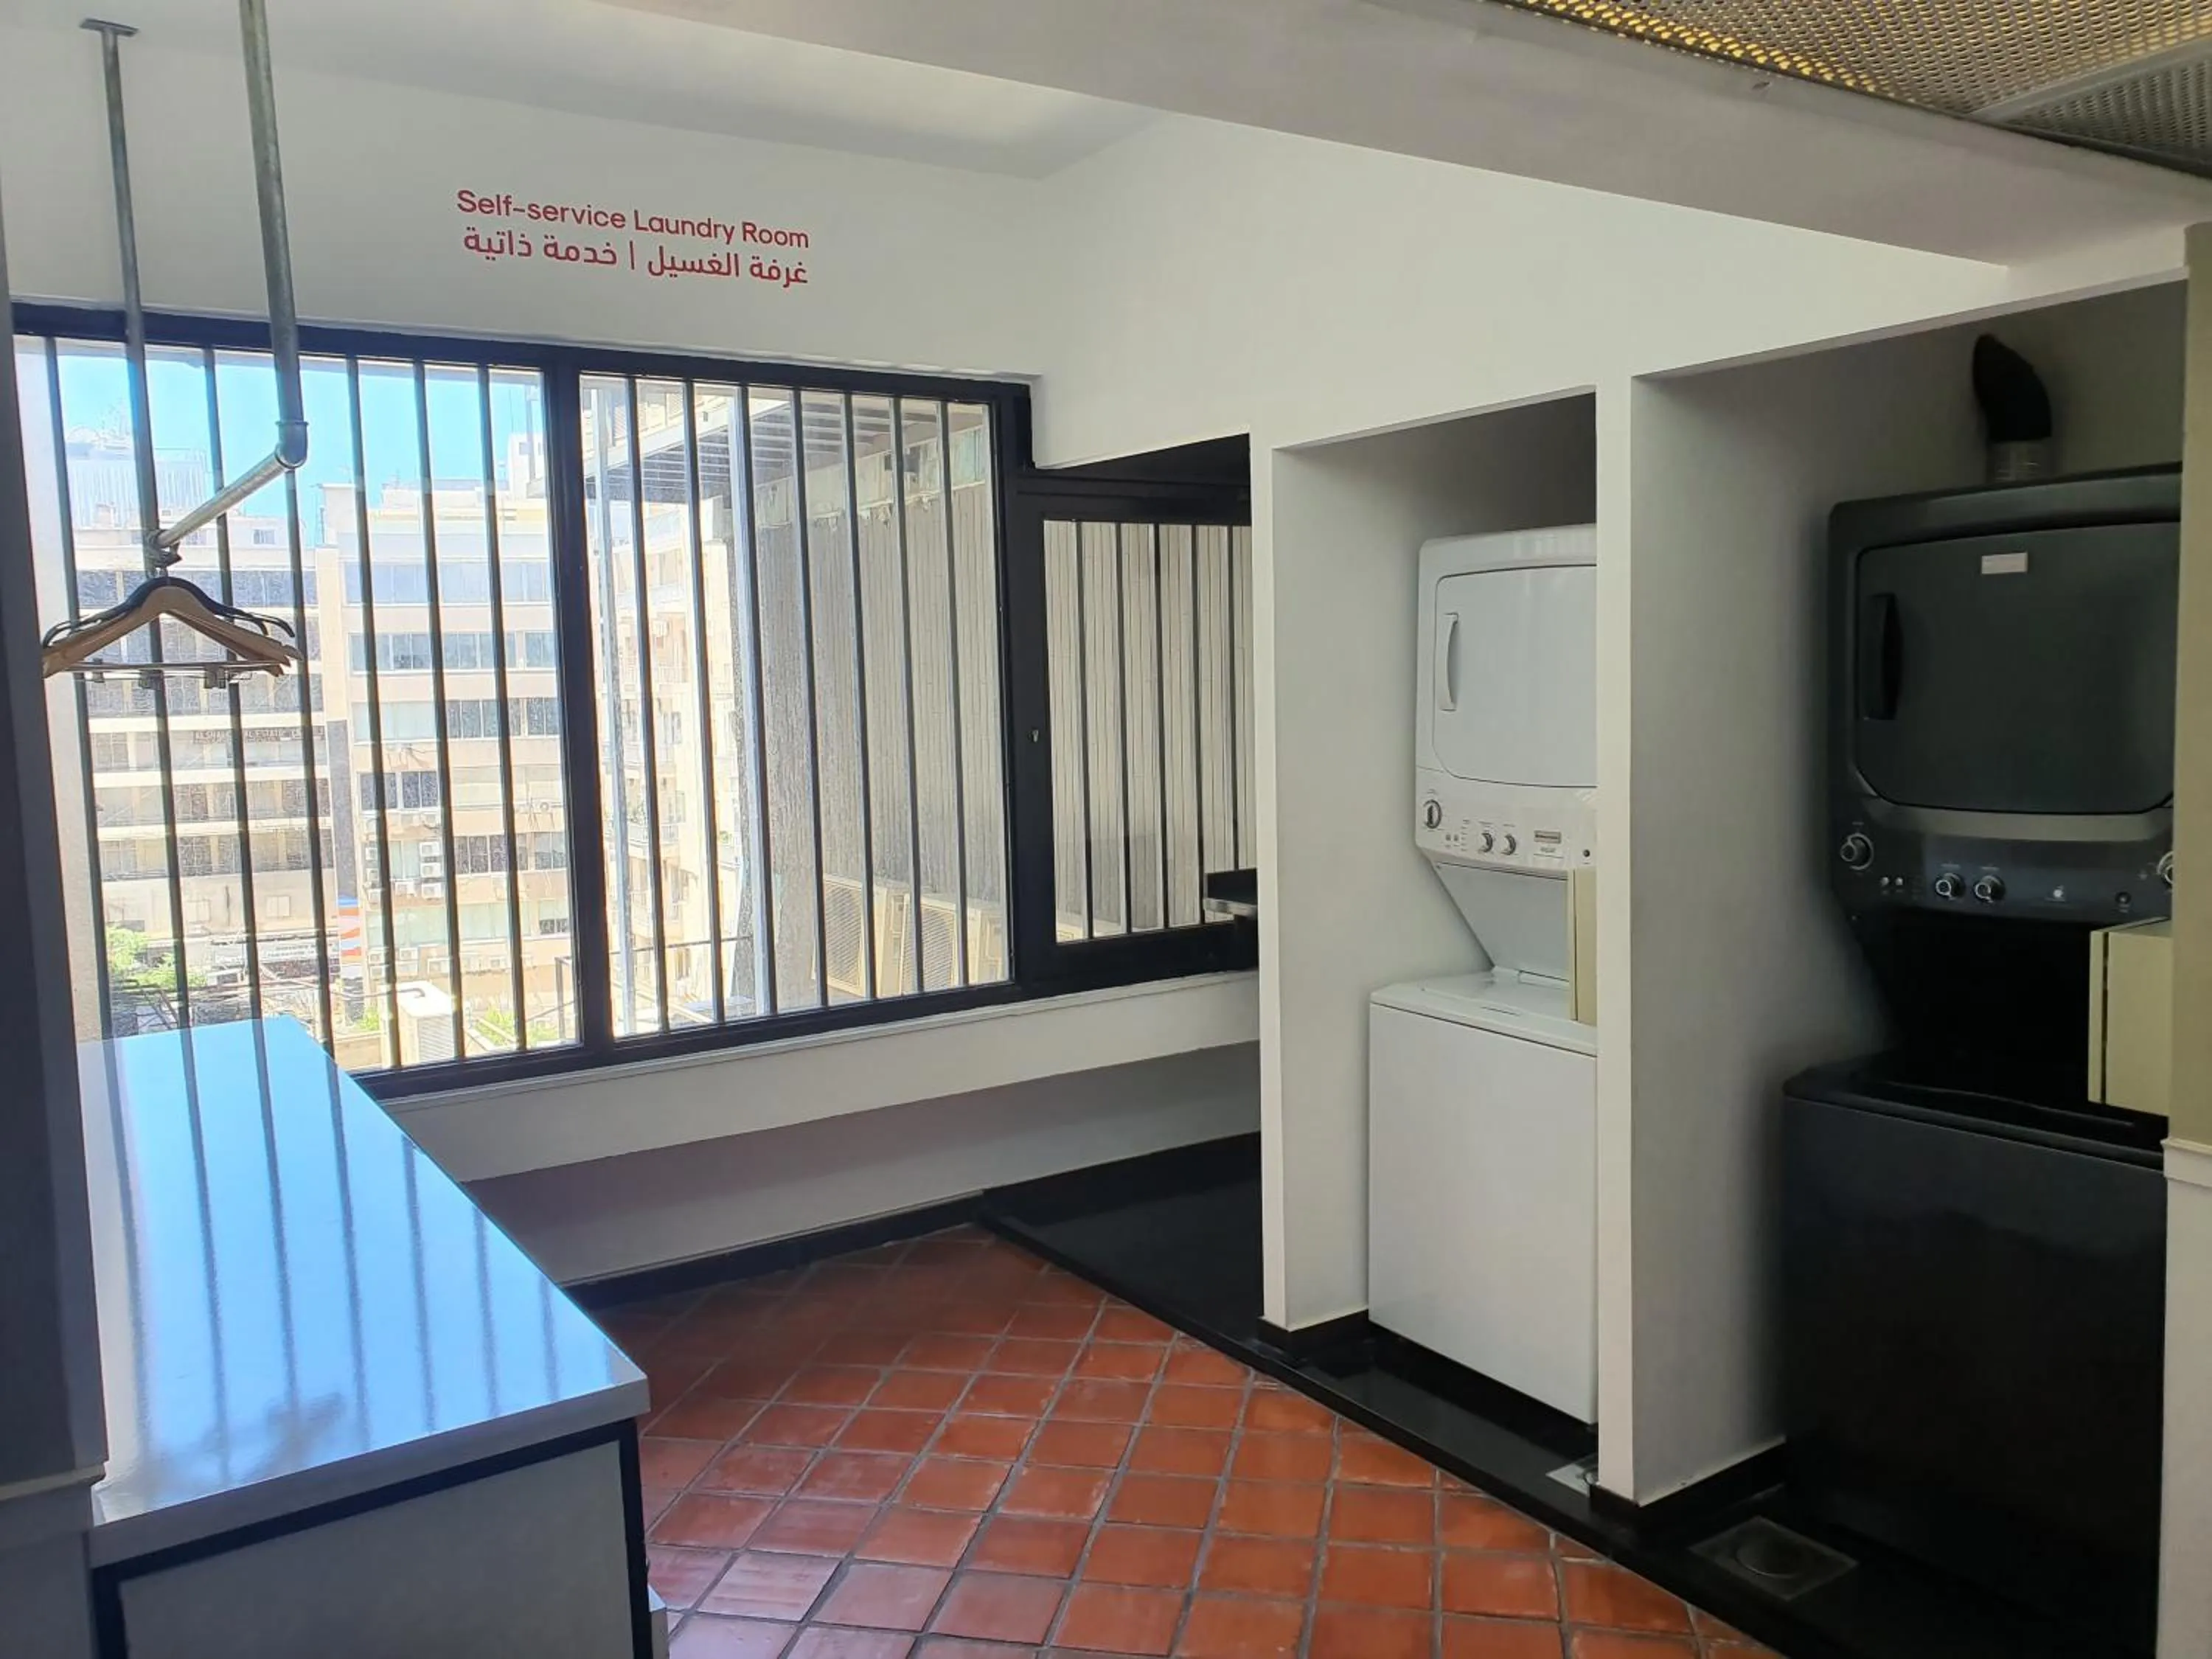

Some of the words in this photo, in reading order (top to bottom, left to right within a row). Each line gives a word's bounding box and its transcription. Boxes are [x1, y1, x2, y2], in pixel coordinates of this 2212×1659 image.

[456, 189, 627, 229] Self-service
[633, 209, 735, 245] Laundry
[741, 221, 810, 248] Room
[463, 226, 532, 262] ذاتية
[543, 233, 618, 266] خدمة
[647, 245, 740, 278] الغسيل
[749, 254, 809, 288] غرفة
